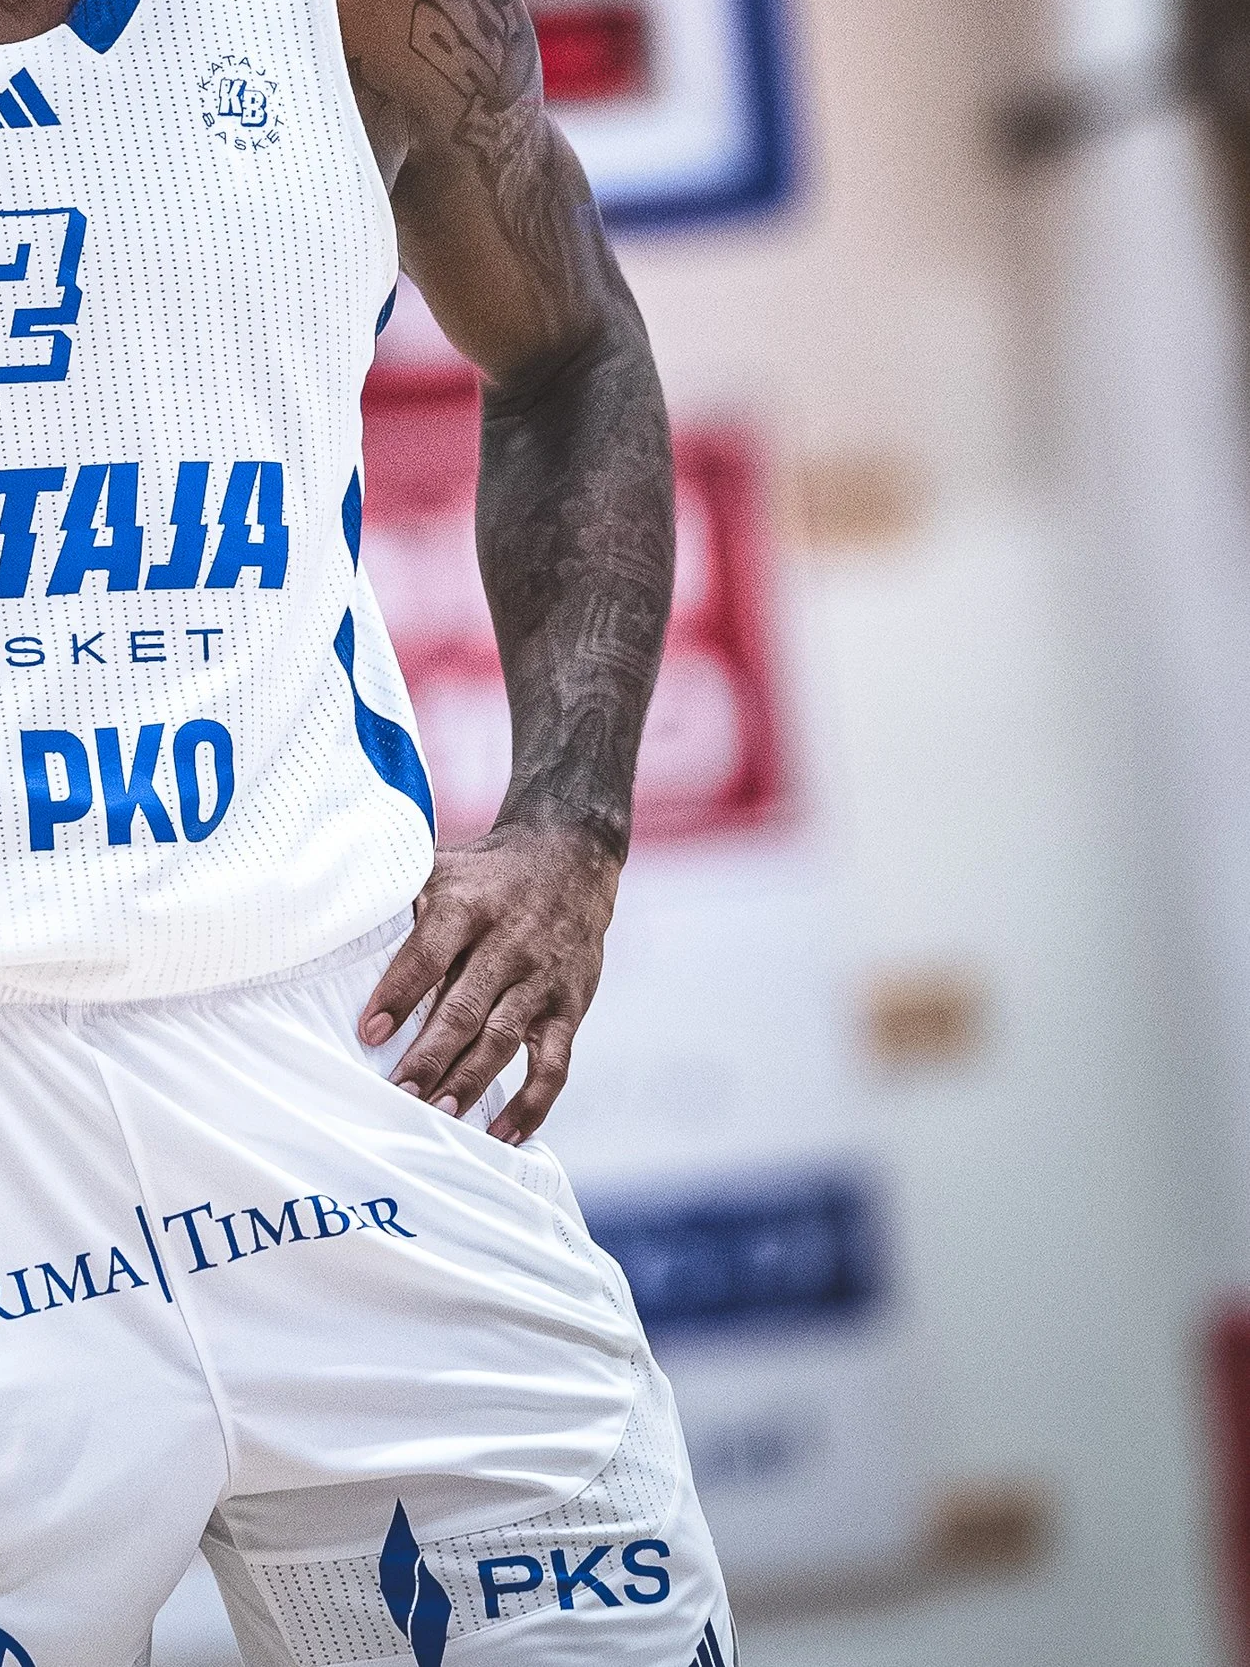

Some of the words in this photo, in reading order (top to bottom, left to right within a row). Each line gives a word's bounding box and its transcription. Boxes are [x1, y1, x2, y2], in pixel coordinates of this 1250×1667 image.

[198, 54, 278, 95] KATAJA
[218, 77, 268, 127] KB
[202, 111, 285, 151] BASKET
[20, 718, 234, 852] PKO
[477, 1539, 671, 1620] PKS
